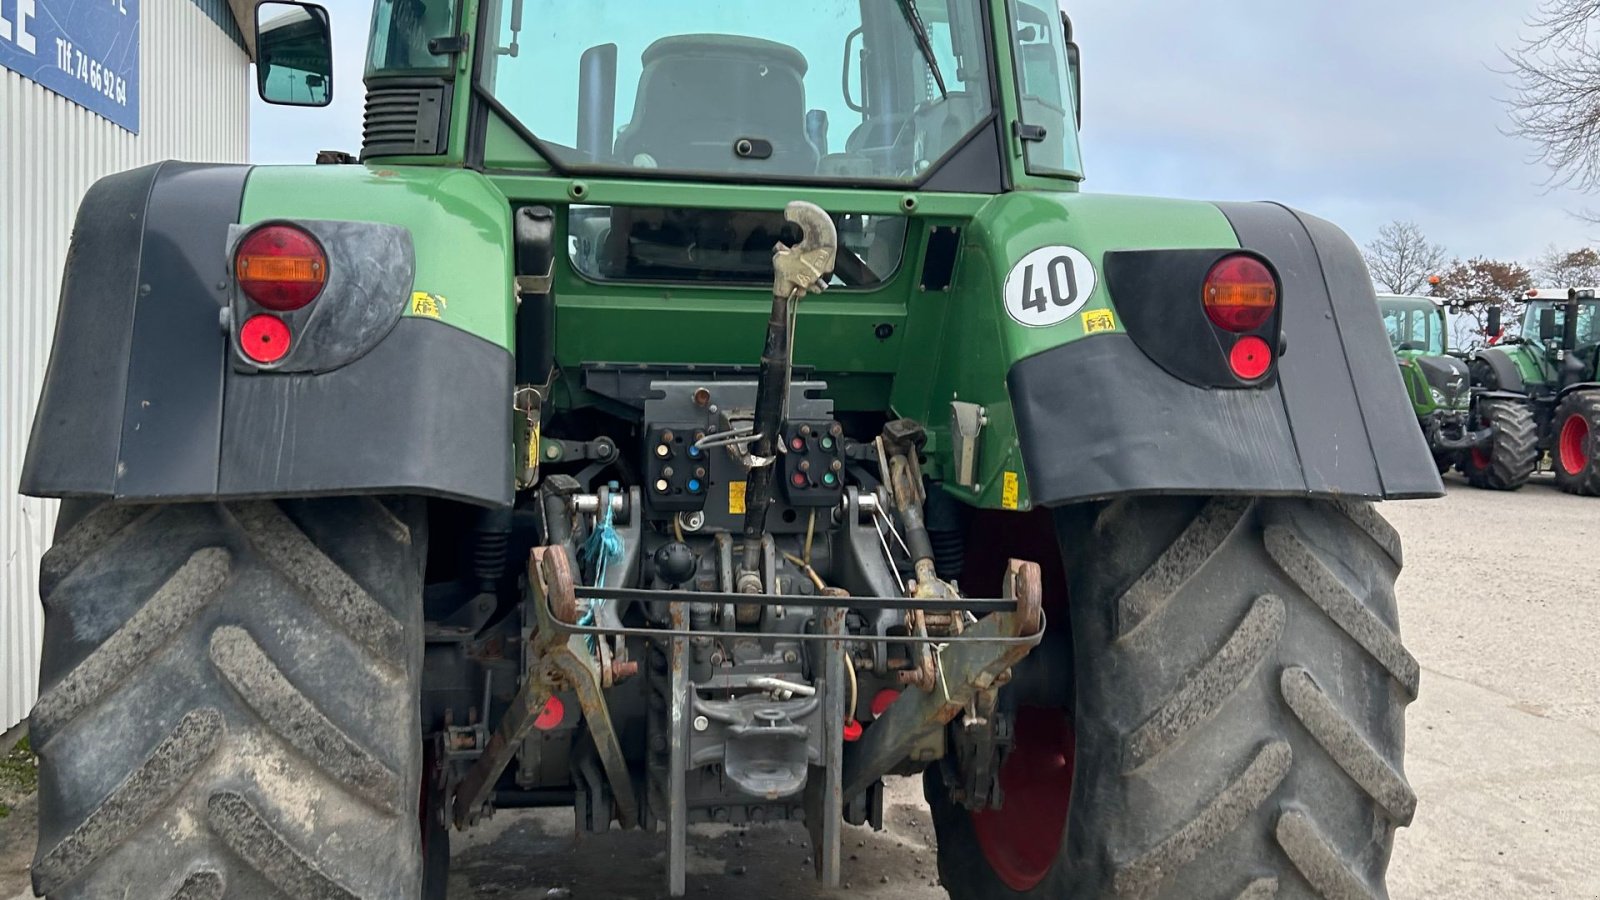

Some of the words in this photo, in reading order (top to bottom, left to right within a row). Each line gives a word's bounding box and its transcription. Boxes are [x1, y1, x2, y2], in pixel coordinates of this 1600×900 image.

[56, 37, 74, 76] Tlf.
[76, 49, 88, 84] 74
[90, 59, 102, 92] 66
[103, 67, 115, 100] 92
[116, 76, 127, 107] 64
[1021, 255, 1078, 313] 40
